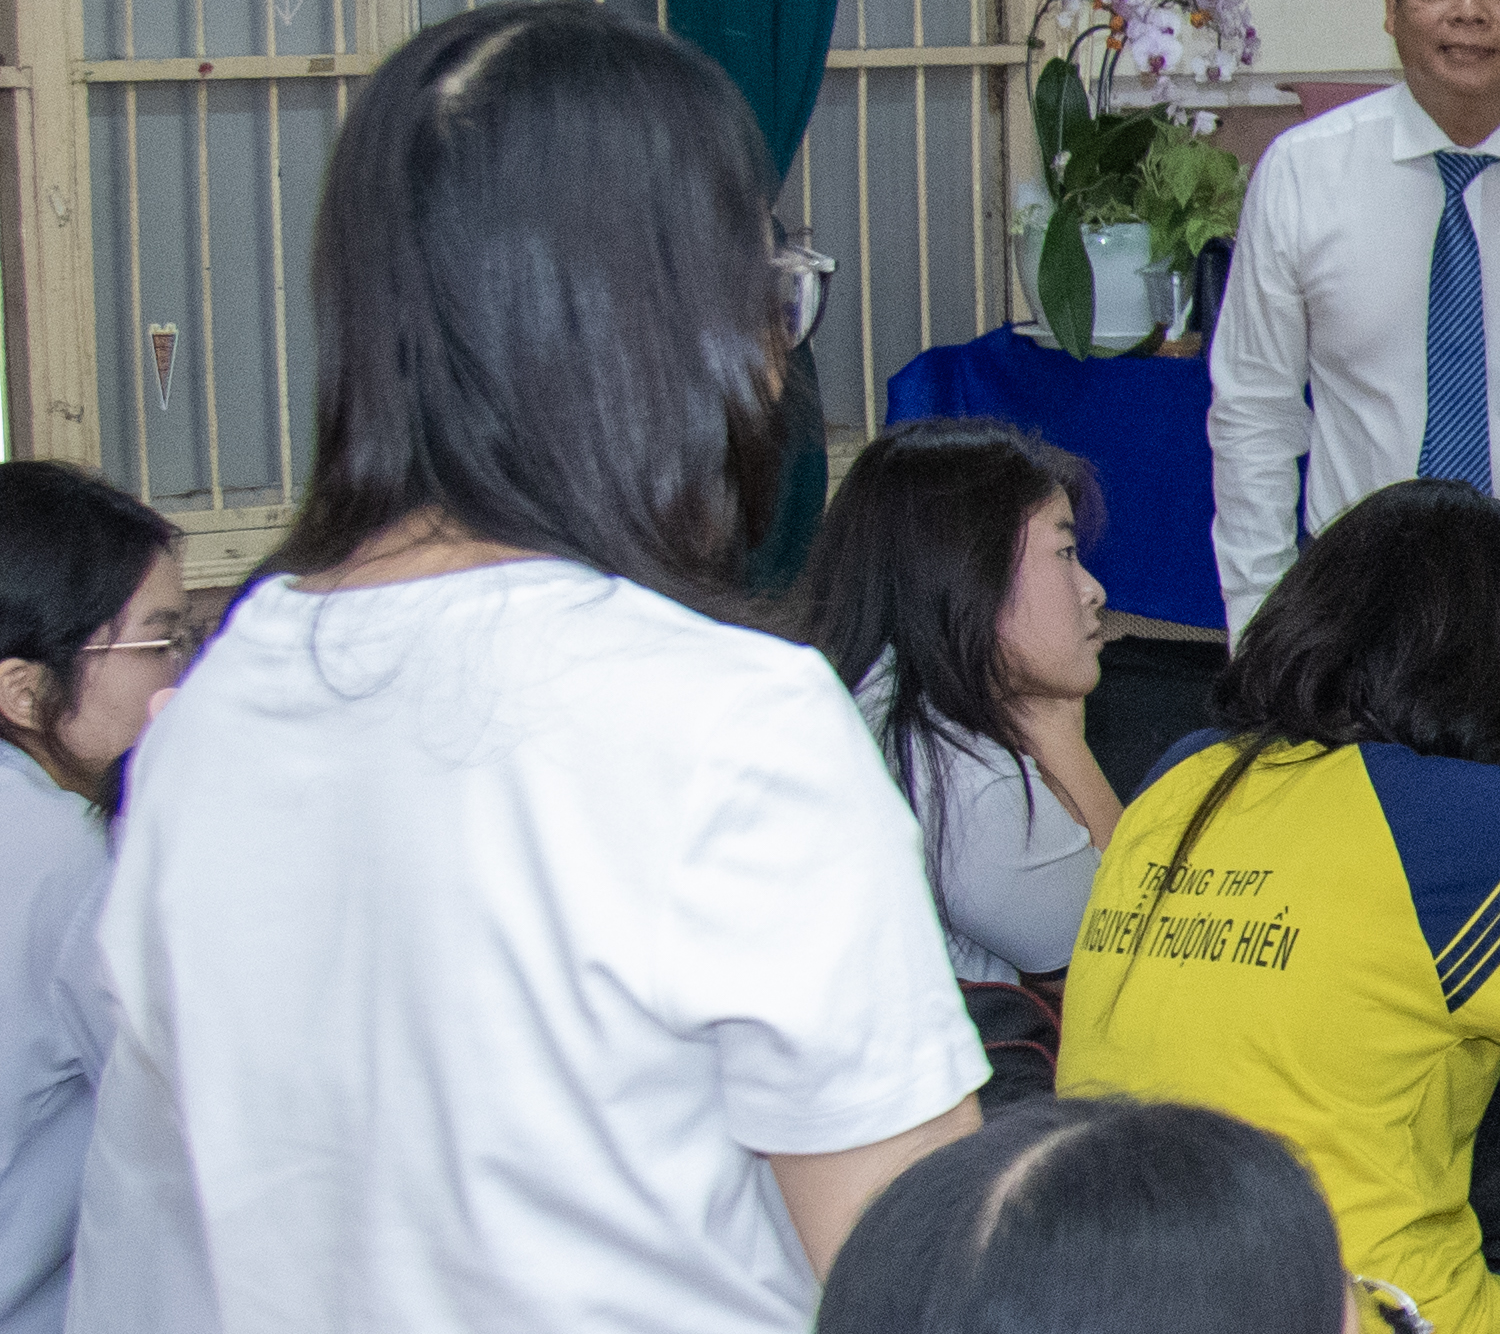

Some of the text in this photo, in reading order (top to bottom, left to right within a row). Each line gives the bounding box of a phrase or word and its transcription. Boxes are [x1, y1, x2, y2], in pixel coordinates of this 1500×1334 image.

[1217, 869, 1274, 897] THPT
[1148, 912, 1234, 968] THƯỢNG
[1231, 905, 1300, 971] HIỀN
